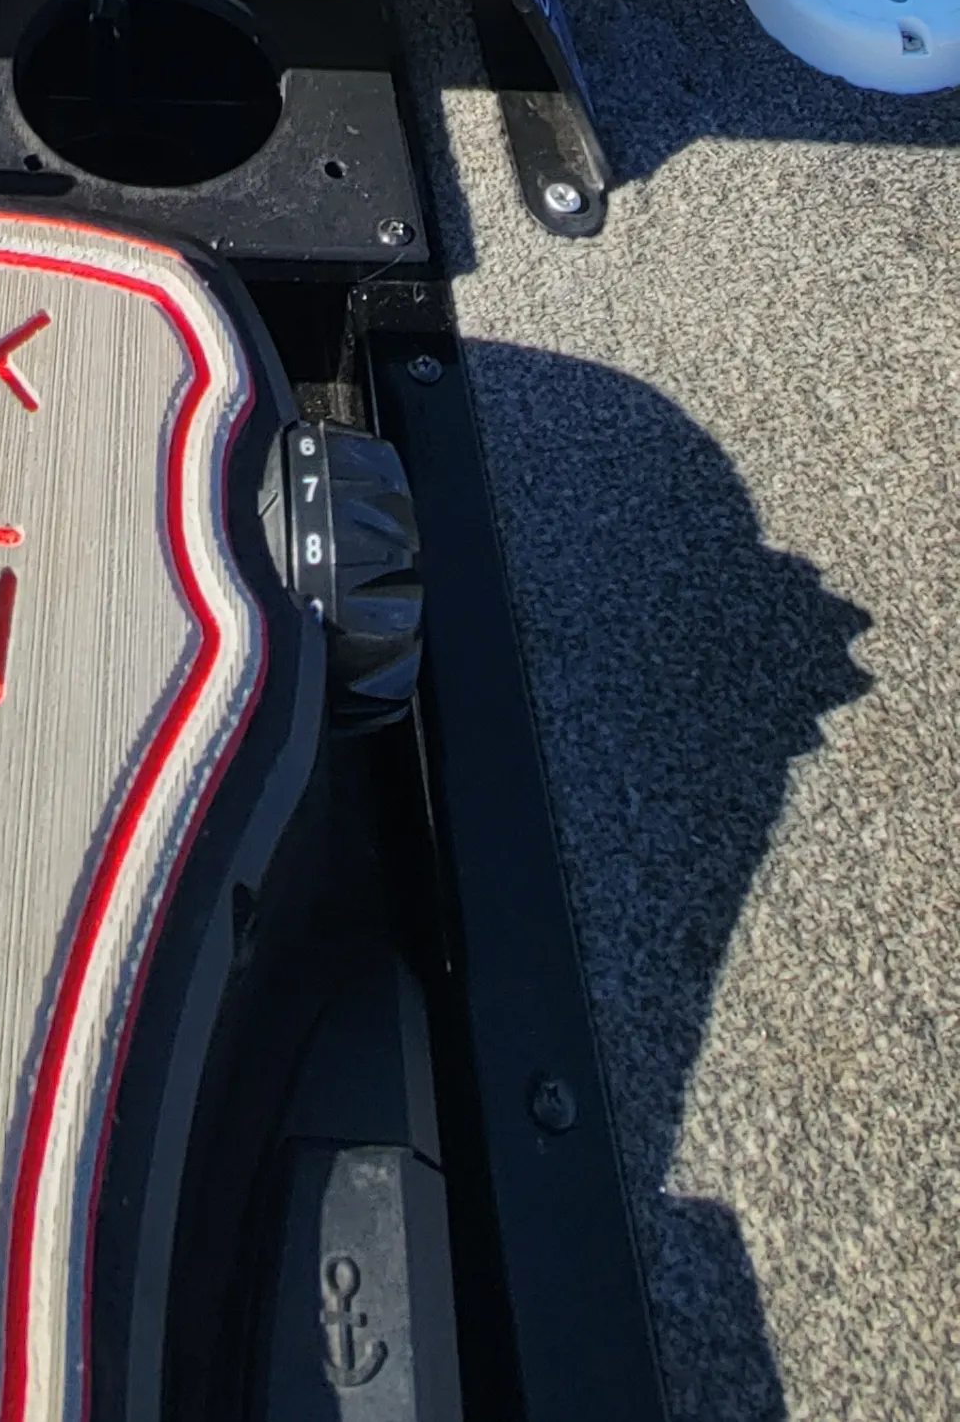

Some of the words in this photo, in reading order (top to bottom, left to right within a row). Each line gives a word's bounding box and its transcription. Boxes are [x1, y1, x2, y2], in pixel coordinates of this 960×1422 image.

[299, 437, 316, 456] 6
[302, 476, 319, 503] 7
[306, 532, 323, 566] 8
